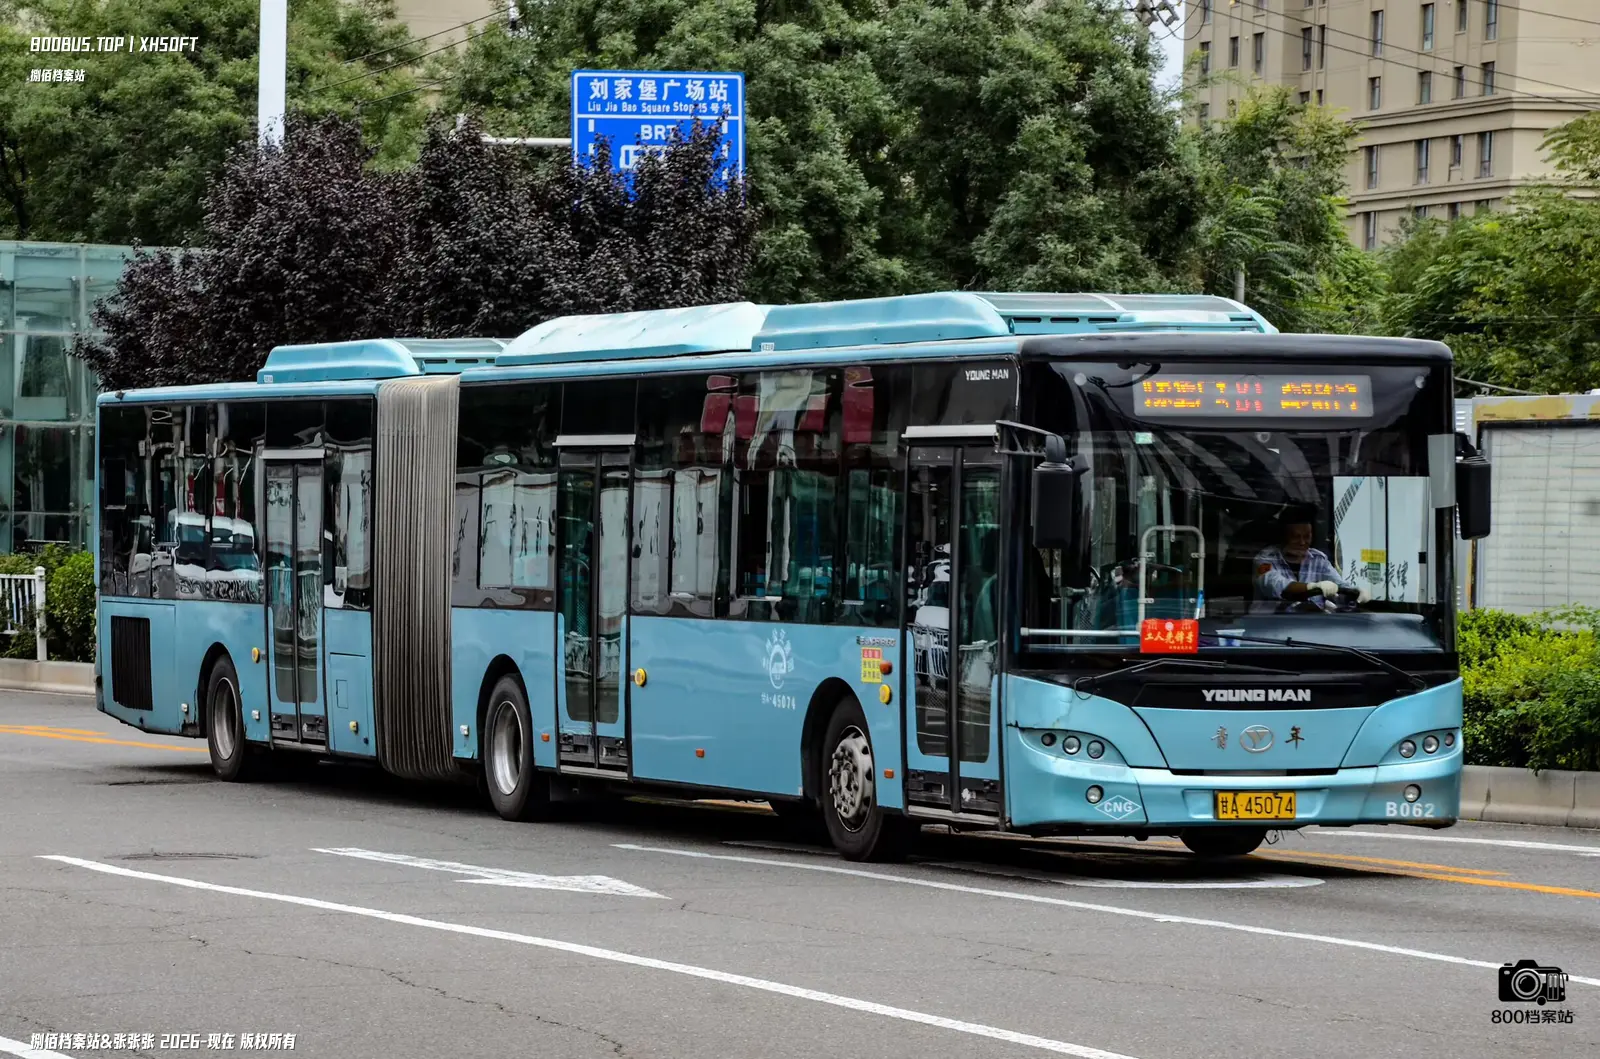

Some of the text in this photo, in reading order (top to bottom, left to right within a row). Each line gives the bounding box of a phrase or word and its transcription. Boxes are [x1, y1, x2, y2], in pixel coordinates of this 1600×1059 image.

[589, 78, 729, 102] 刘家堡广场站
[588, 102, 601, 112] Liu
[604, 102, 618, 112] Jia
[622, 102, 637, 112] Bao
[641, 103, 670, 114] Square
[673, 102, 694, 114] Stop
[965, 368, 1009, 381] YOUNG MAN
[1202, 689, 1311, 702] YOUNG MAN
[1104, 801, 1133, 813] CNG
[1385, 801, 1436, 818] B062
